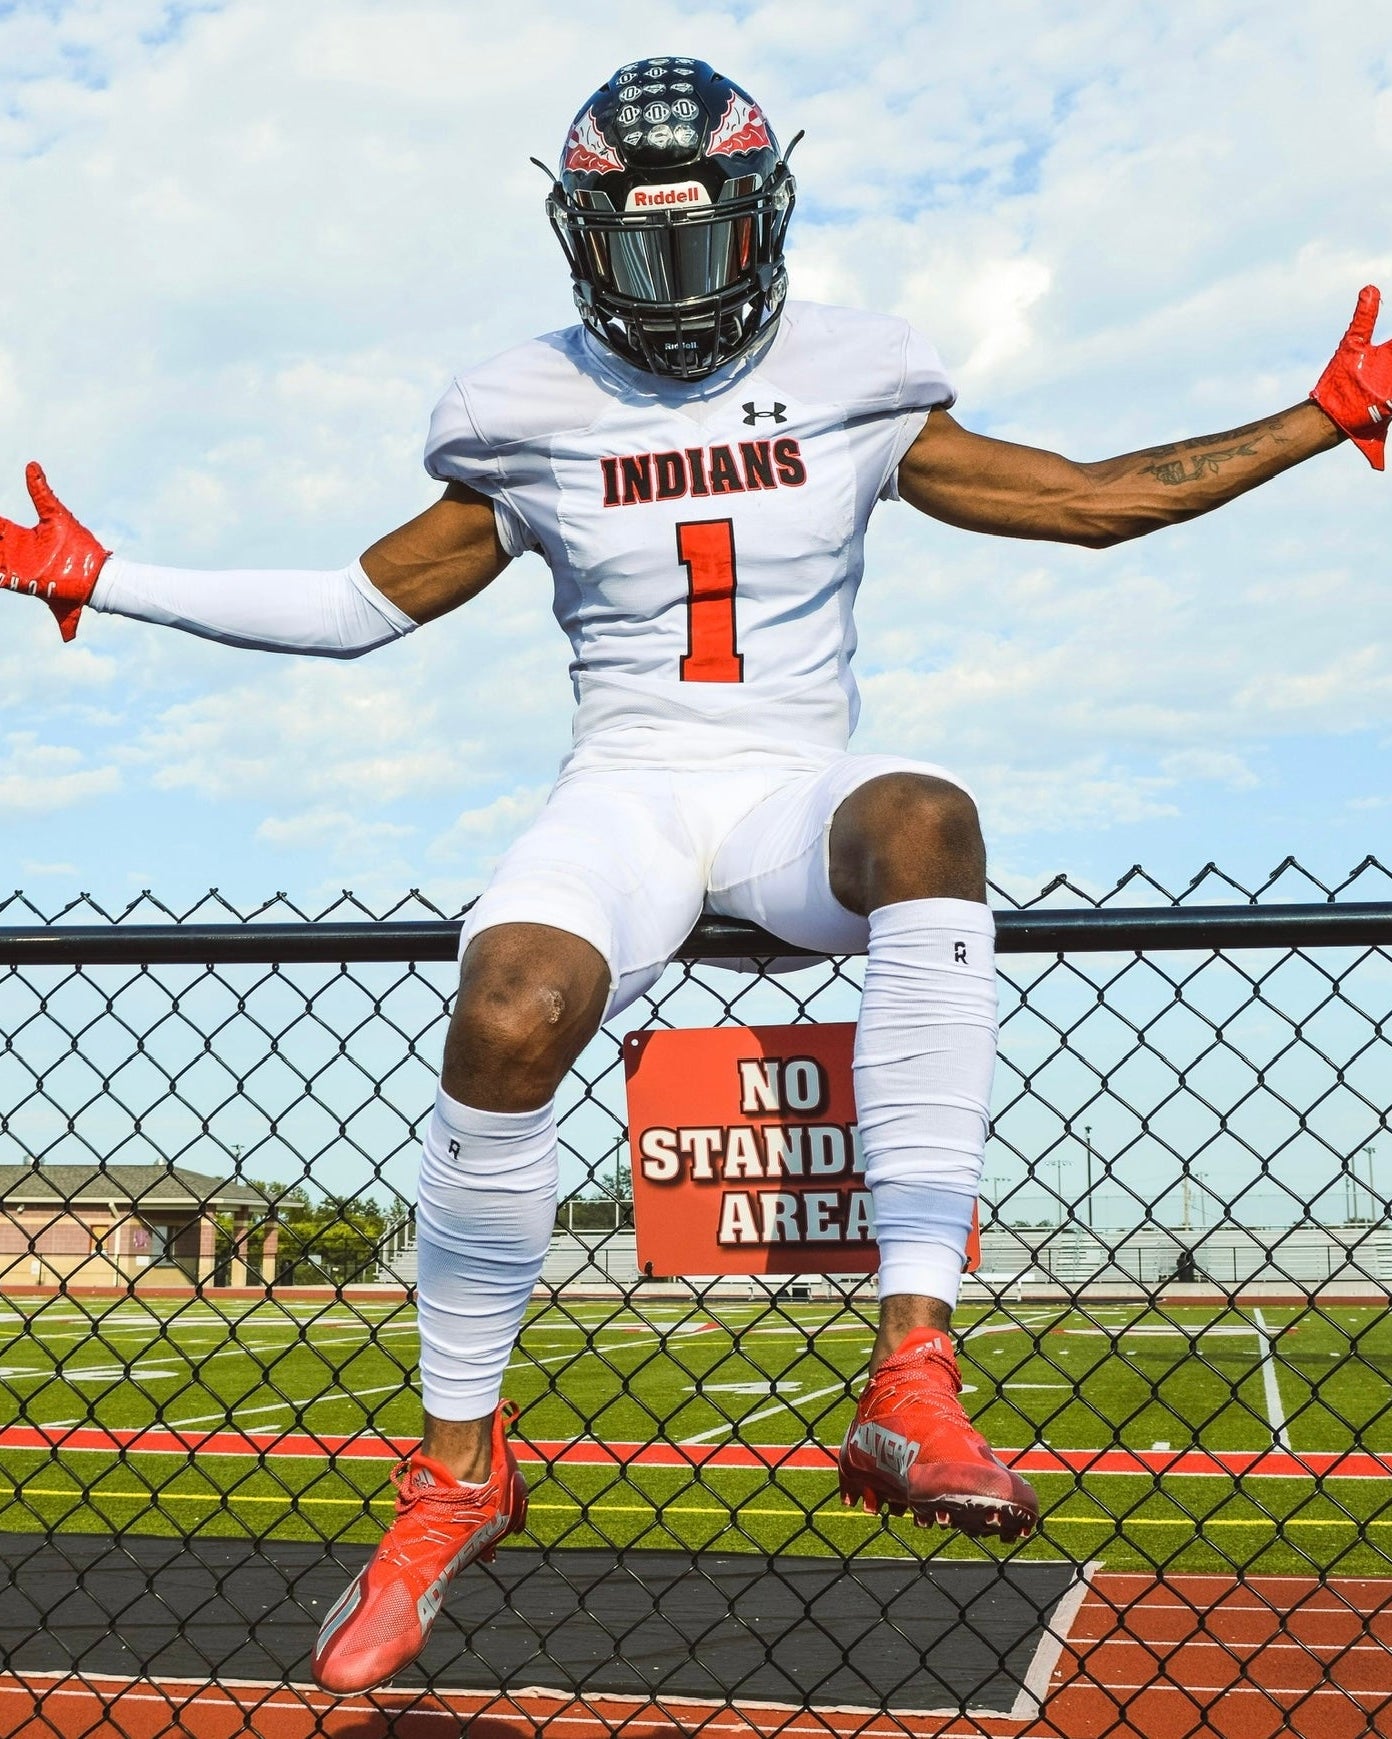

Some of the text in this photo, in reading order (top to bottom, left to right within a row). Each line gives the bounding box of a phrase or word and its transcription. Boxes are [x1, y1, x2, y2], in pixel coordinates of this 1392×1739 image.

[635, 188, 699, 206] Riddell
[600, 438, 807, 507] INDIANS
[676, 518, 744, 683] 1
[739, 1059, 821, 1113] NO
[718, 1191, 878, 1244] AREA
